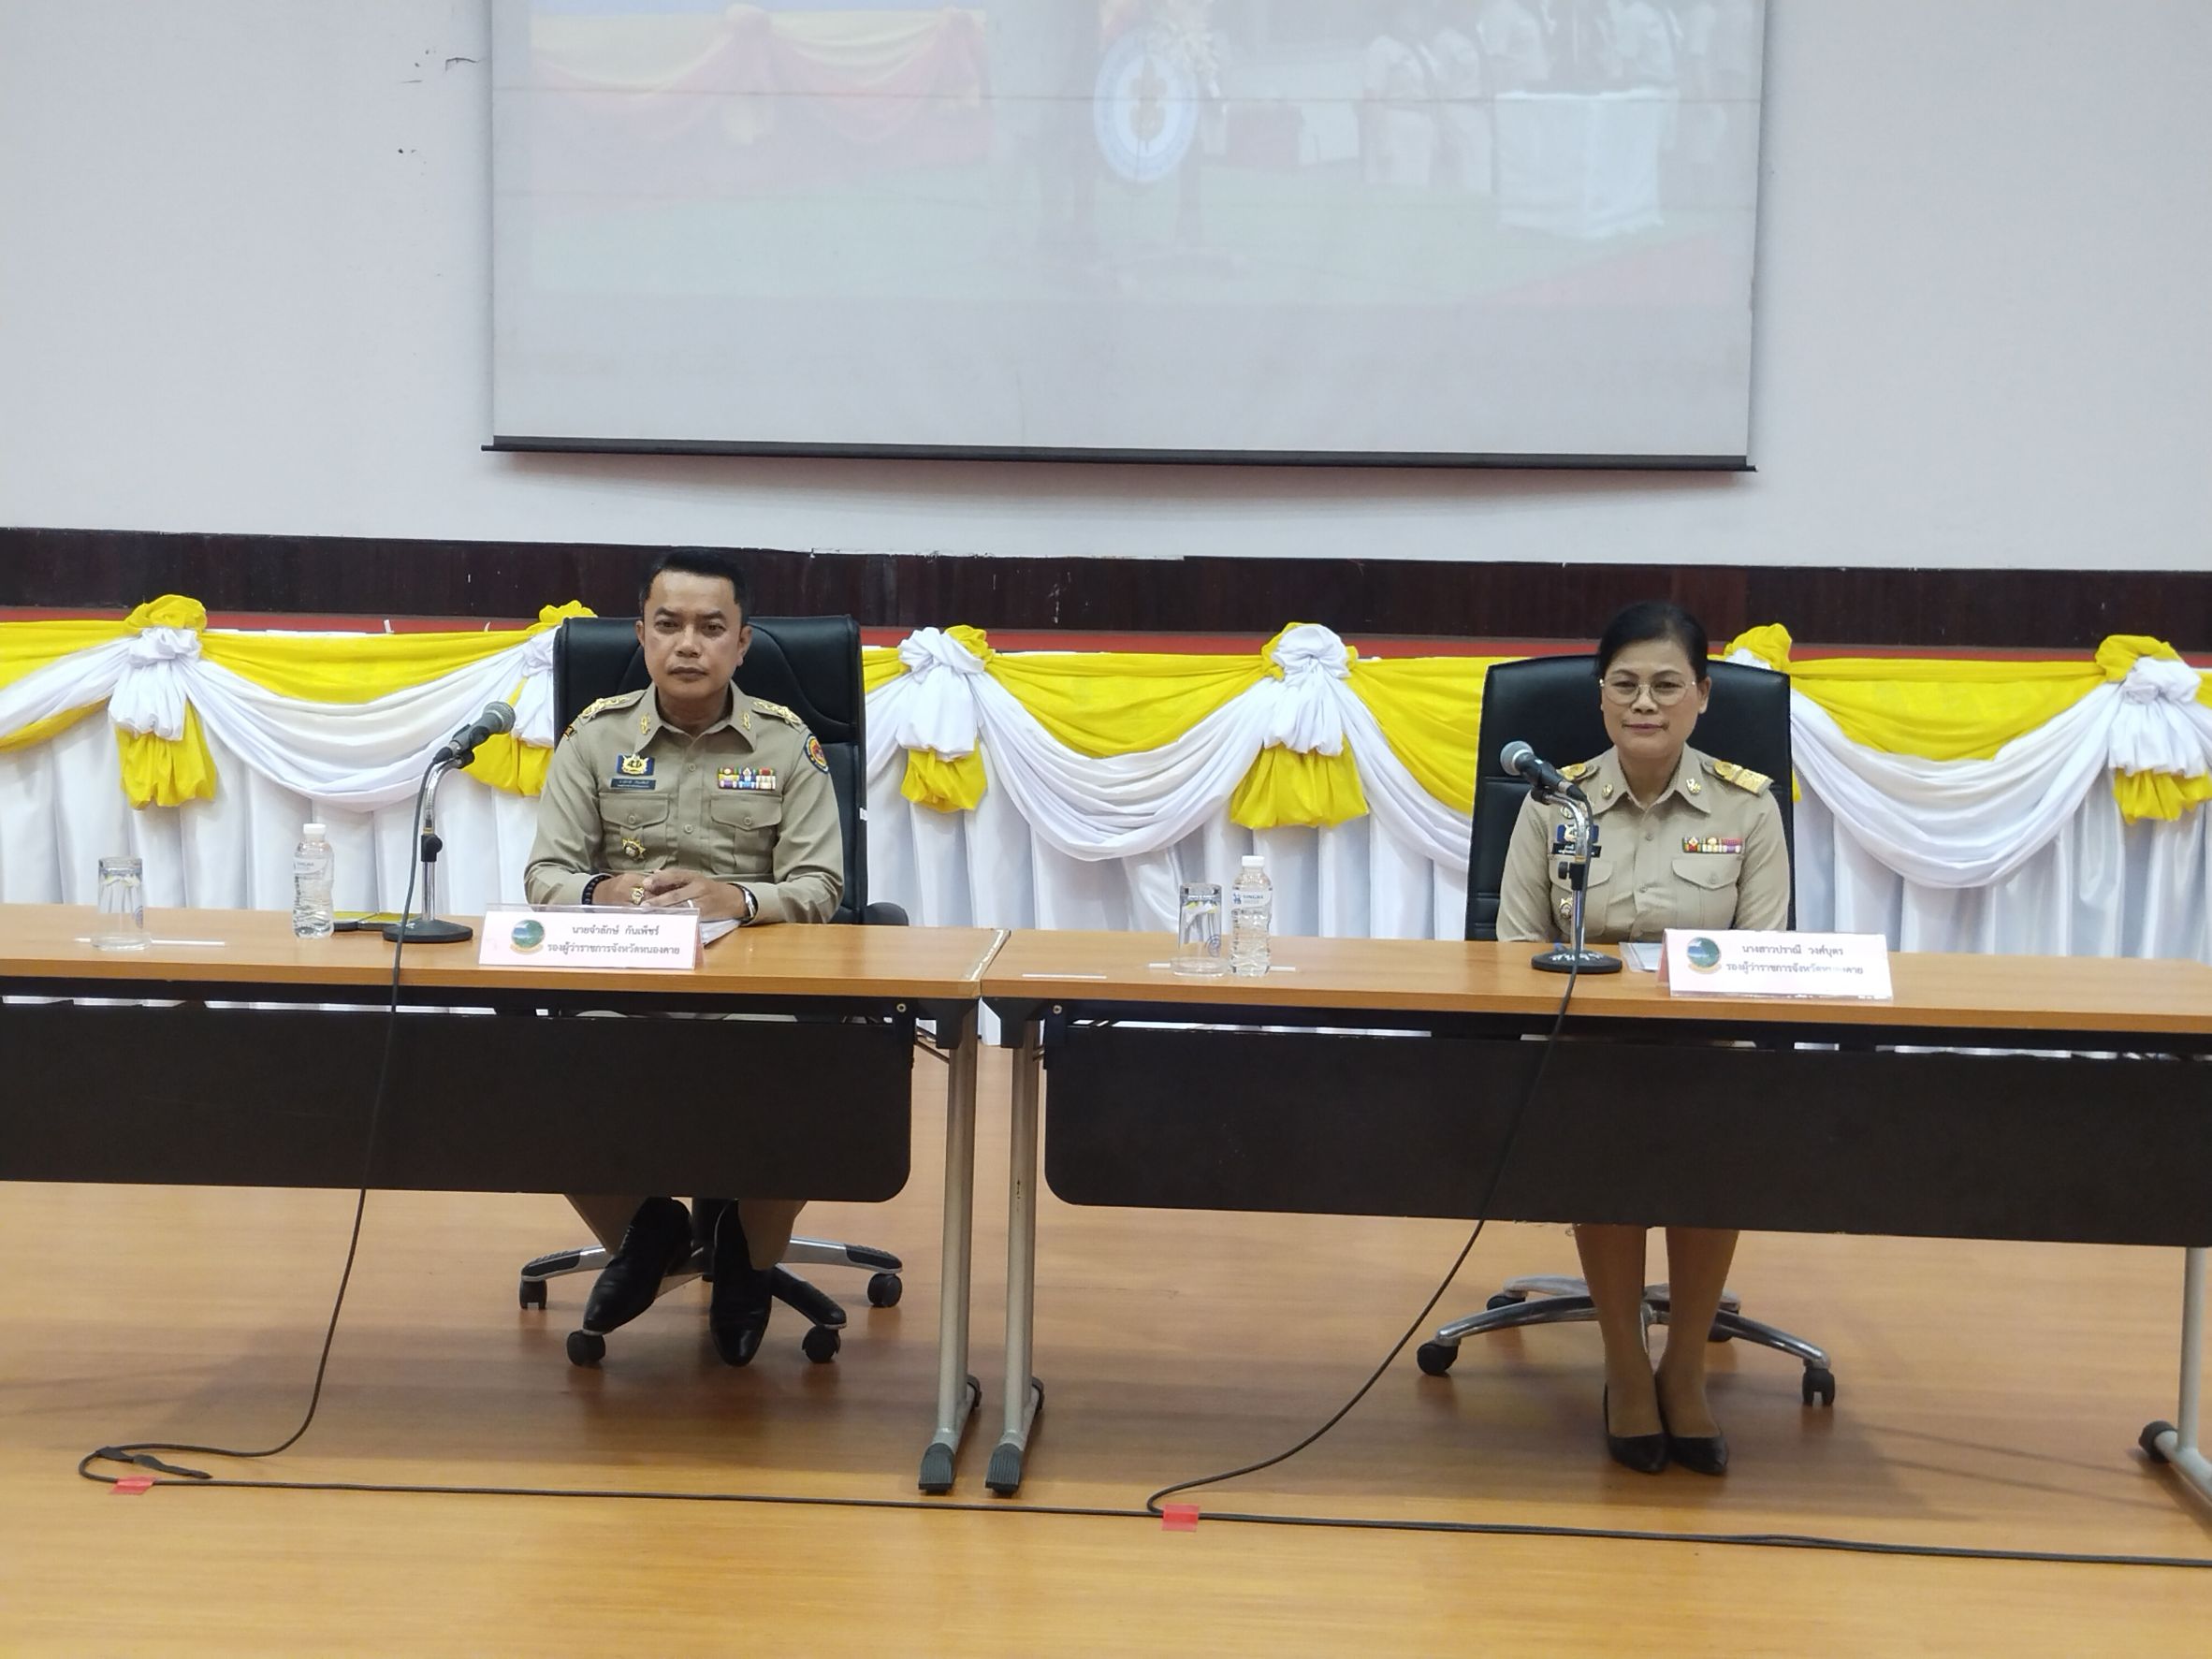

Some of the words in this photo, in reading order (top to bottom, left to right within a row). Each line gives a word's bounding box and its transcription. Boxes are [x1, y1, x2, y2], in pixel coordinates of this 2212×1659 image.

[572, 924, 619, 935] นายจำลักษ์
[547, 941, 680, 955] รองผู้ว่าราชการจังหวัดหนองคาย
[1741, 944, 1801, 953] นางสาวปราณี
